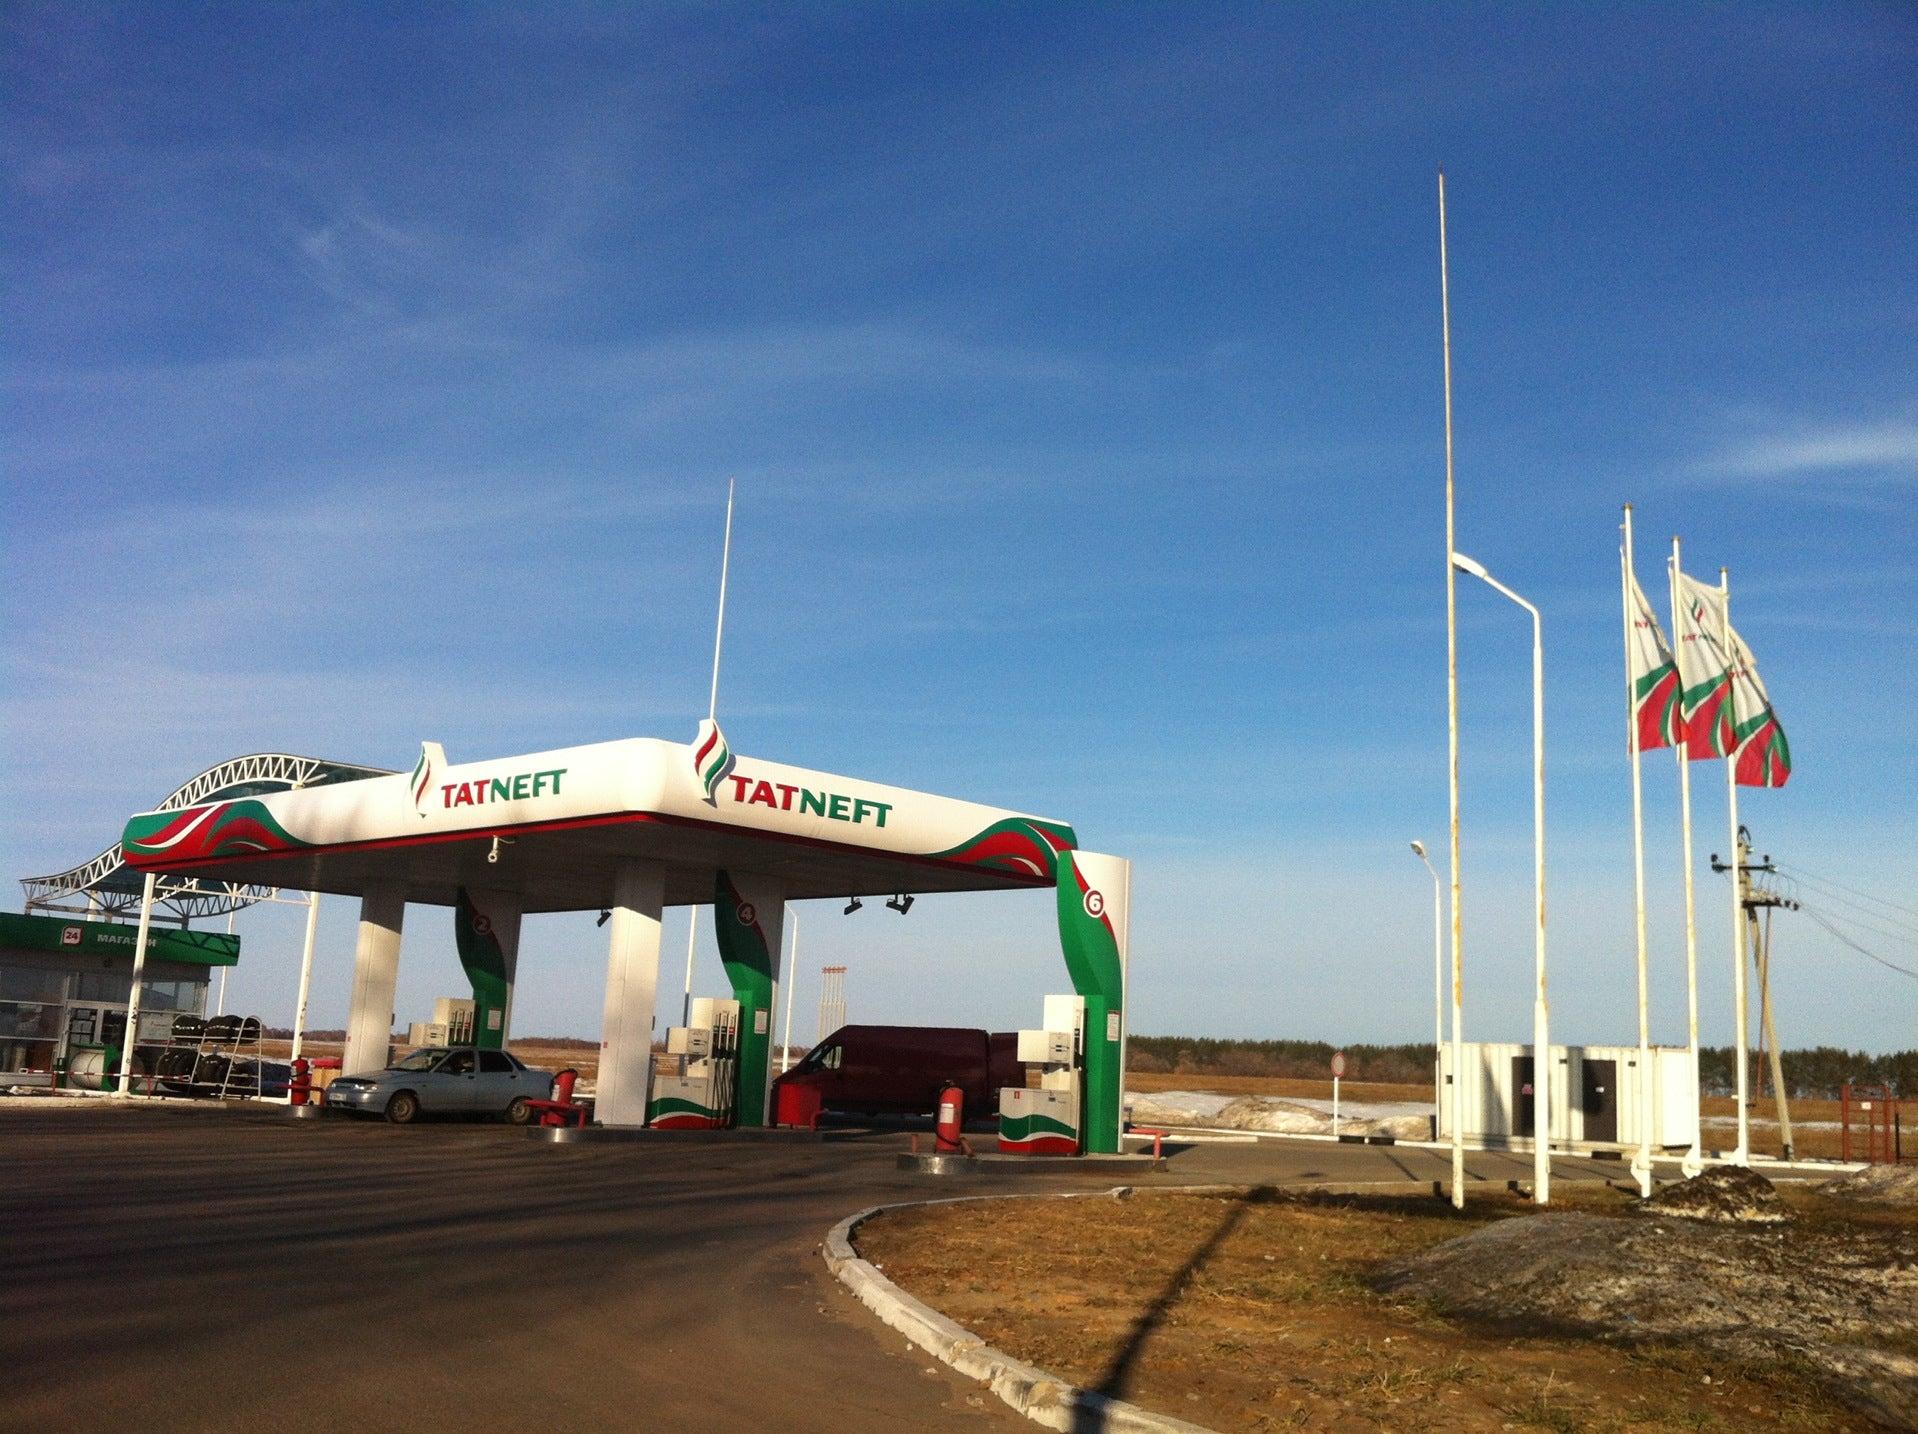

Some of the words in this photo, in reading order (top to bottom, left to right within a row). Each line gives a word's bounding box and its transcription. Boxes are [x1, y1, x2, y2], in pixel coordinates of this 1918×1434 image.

[441, 768, 567, 808] TATNEFT
[728, 775, 892, 828] TATNEFT
[1089, 894, 1101, 912] 6
[66, 931, 79, 940] 24
[97, 934, 157, 947] МАГАЗН
